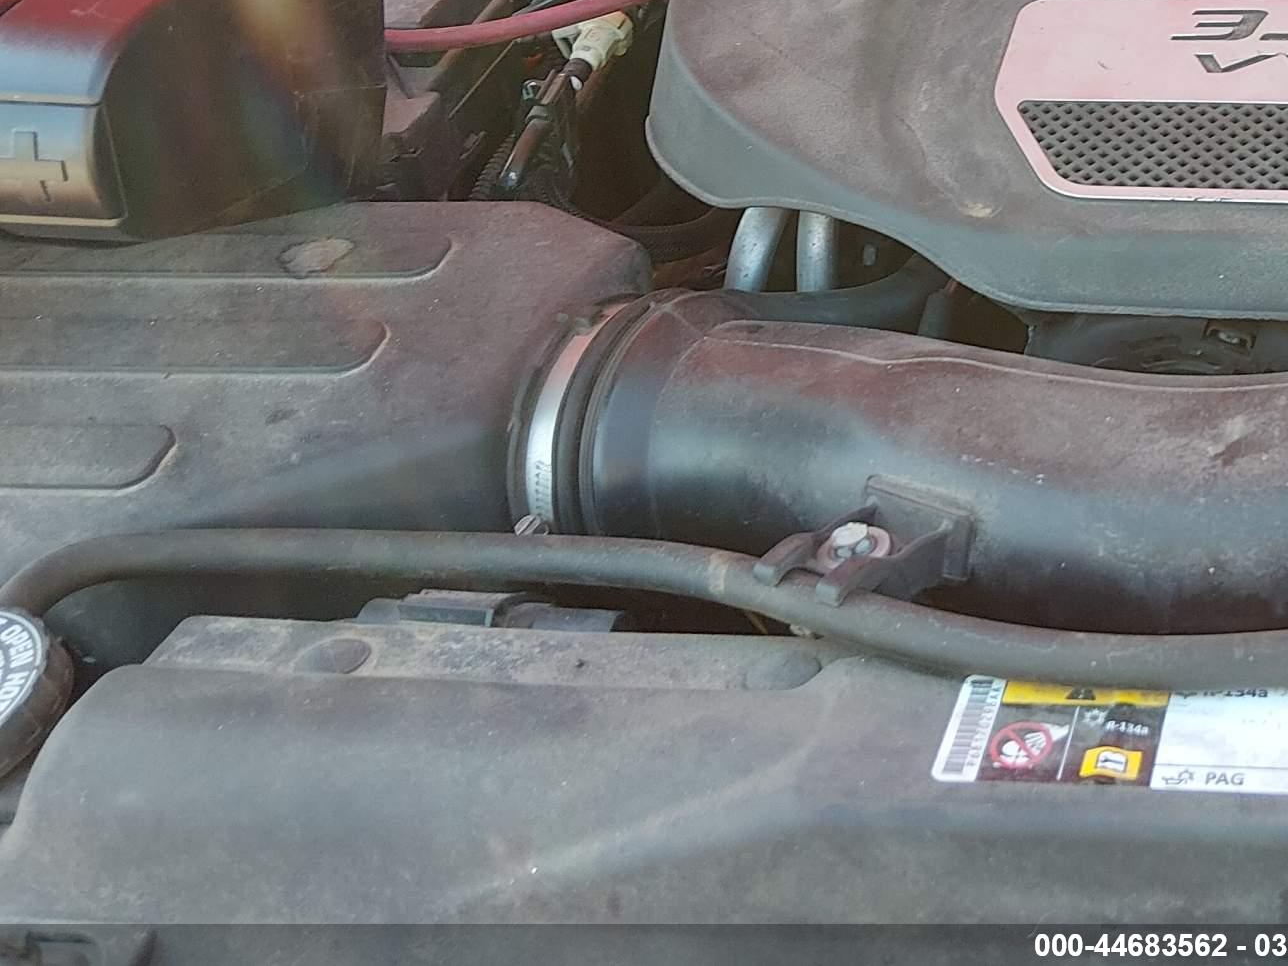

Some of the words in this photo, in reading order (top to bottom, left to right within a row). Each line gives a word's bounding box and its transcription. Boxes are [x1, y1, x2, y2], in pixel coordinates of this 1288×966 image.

[0, 623, 35, 669] OPEN
[1105, 719, 1150, 735] R-134a
[1204, 772, 1246, 786] PAG
